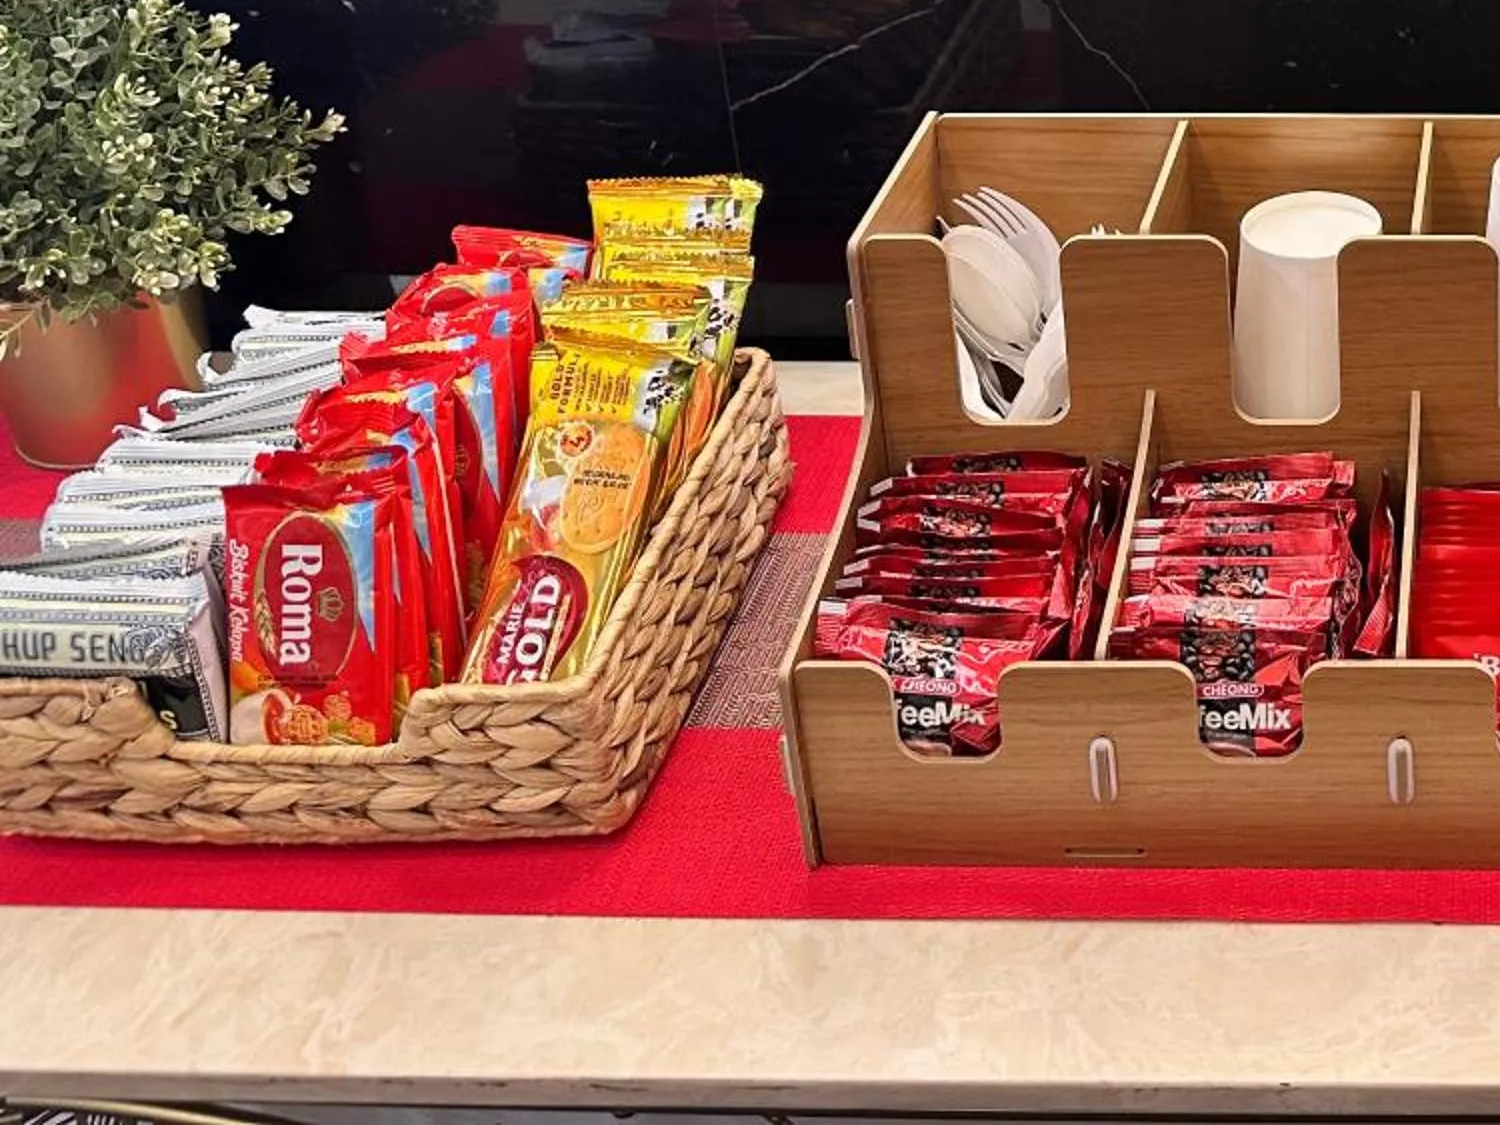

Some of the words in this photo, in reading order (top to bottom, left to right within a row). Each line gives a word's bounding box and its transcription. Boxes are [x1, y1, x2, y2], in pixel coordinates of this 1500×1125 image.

[279, 544, 323, 667] Roma
[2, 630, 57, 661] HUP
[70, 632, 147, 664] SENG
[496, 602, 525, 665] MARIE
[1203, 683, 1260, 697] CHEONG
[1200, 703, 1291, 730] feeMix
